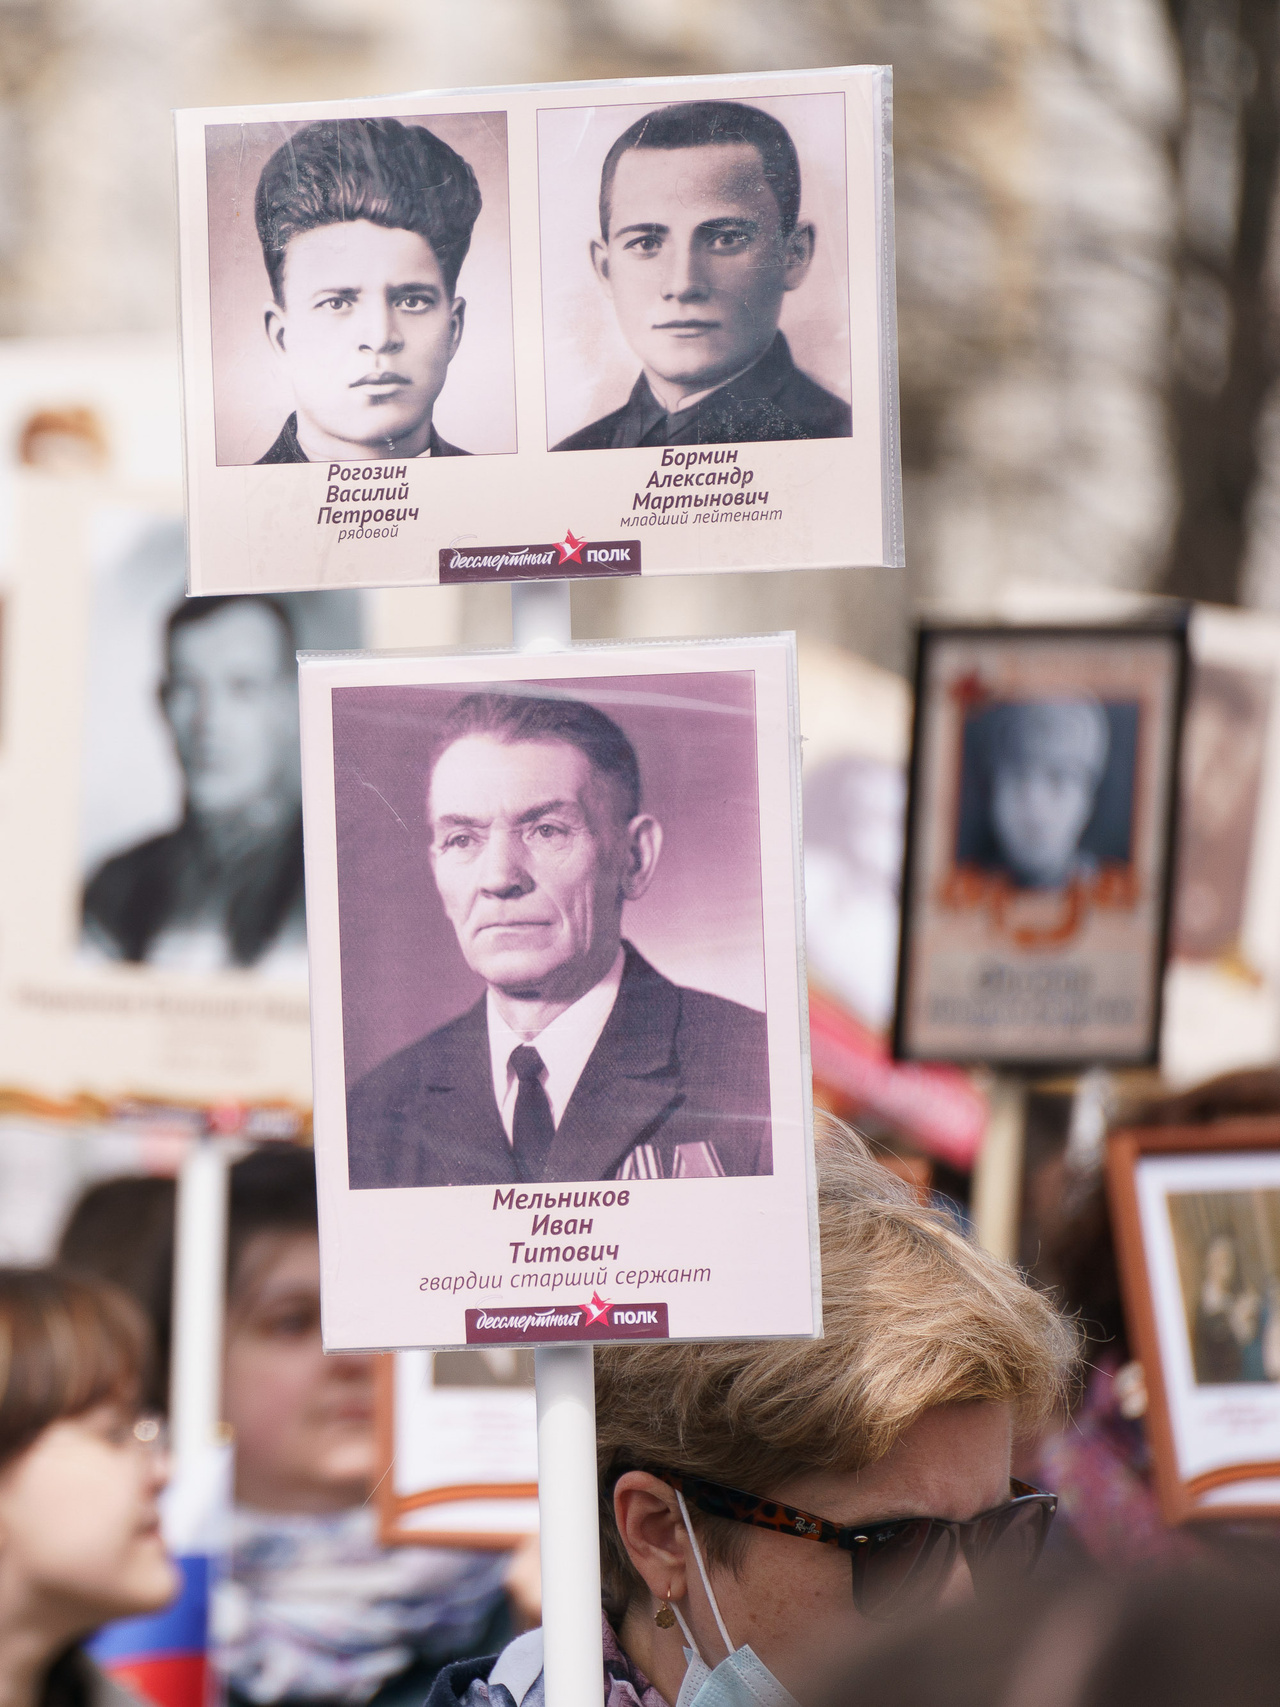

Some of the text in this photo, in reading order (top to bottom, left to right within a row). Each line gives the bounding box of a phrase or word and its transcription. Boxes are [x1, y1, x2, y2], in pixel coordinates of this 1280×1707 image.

[660, 448, 740, 470] Бормин
[326, 463, 408, 483] Рогозин
[645, 466, 754, 489] Александр
[325, 482, 410, 504] Василий
[632, 492, 770, 514] Мартынович
[316, 506, 420, 528] Петрович
[620, 508, 784, 527] младший лейтенант
[337, 524, 399, 544] рядовой
[586, 548, 631, 562] ПОЛК
[492, 1188, 631, 1211] Мельников
[530, 1213, 594, 1237] Иван
[509, 1241, 620, 1264] Титович
[419, 1266, 712, 1295] гвардии старший сержант
[613, 1310, 659, 1325] ПОЛК
